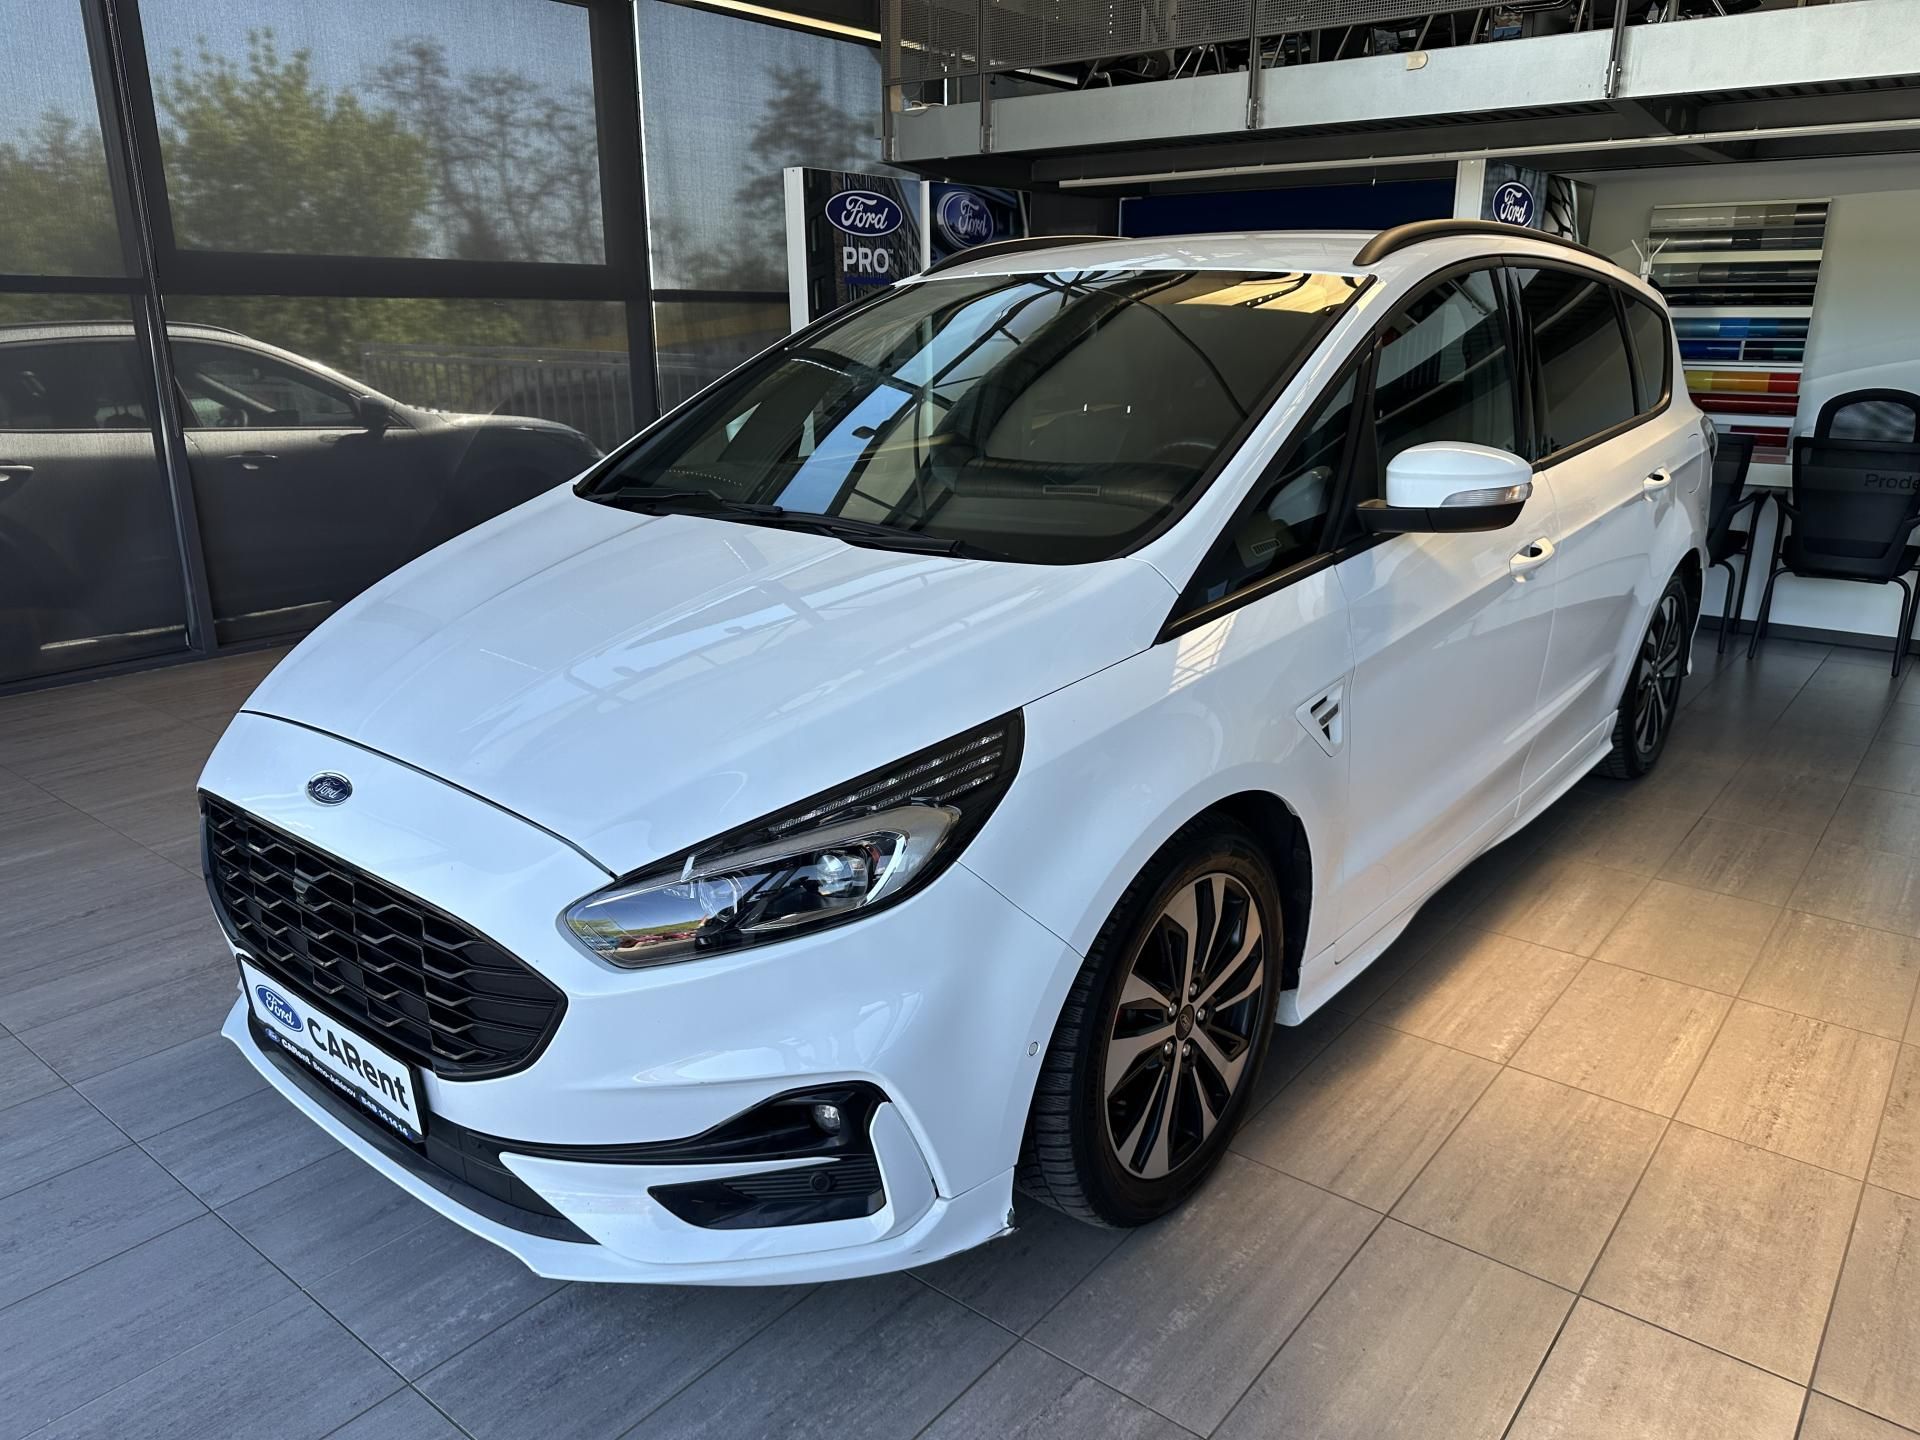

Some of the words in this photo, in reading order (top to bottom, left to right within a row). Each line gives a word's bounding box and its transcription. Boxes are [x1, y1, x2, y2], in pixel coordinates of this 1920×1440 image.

[841, 195, 889, 229] Ford
[957, 200, 987, 235] Ford
[1500, 188, 1527, 222] Ford
[314, 777, 343, 799] Ford
[265, 991, 295, 1026] Ford
[306, 1017, 409, 1112] CARent
